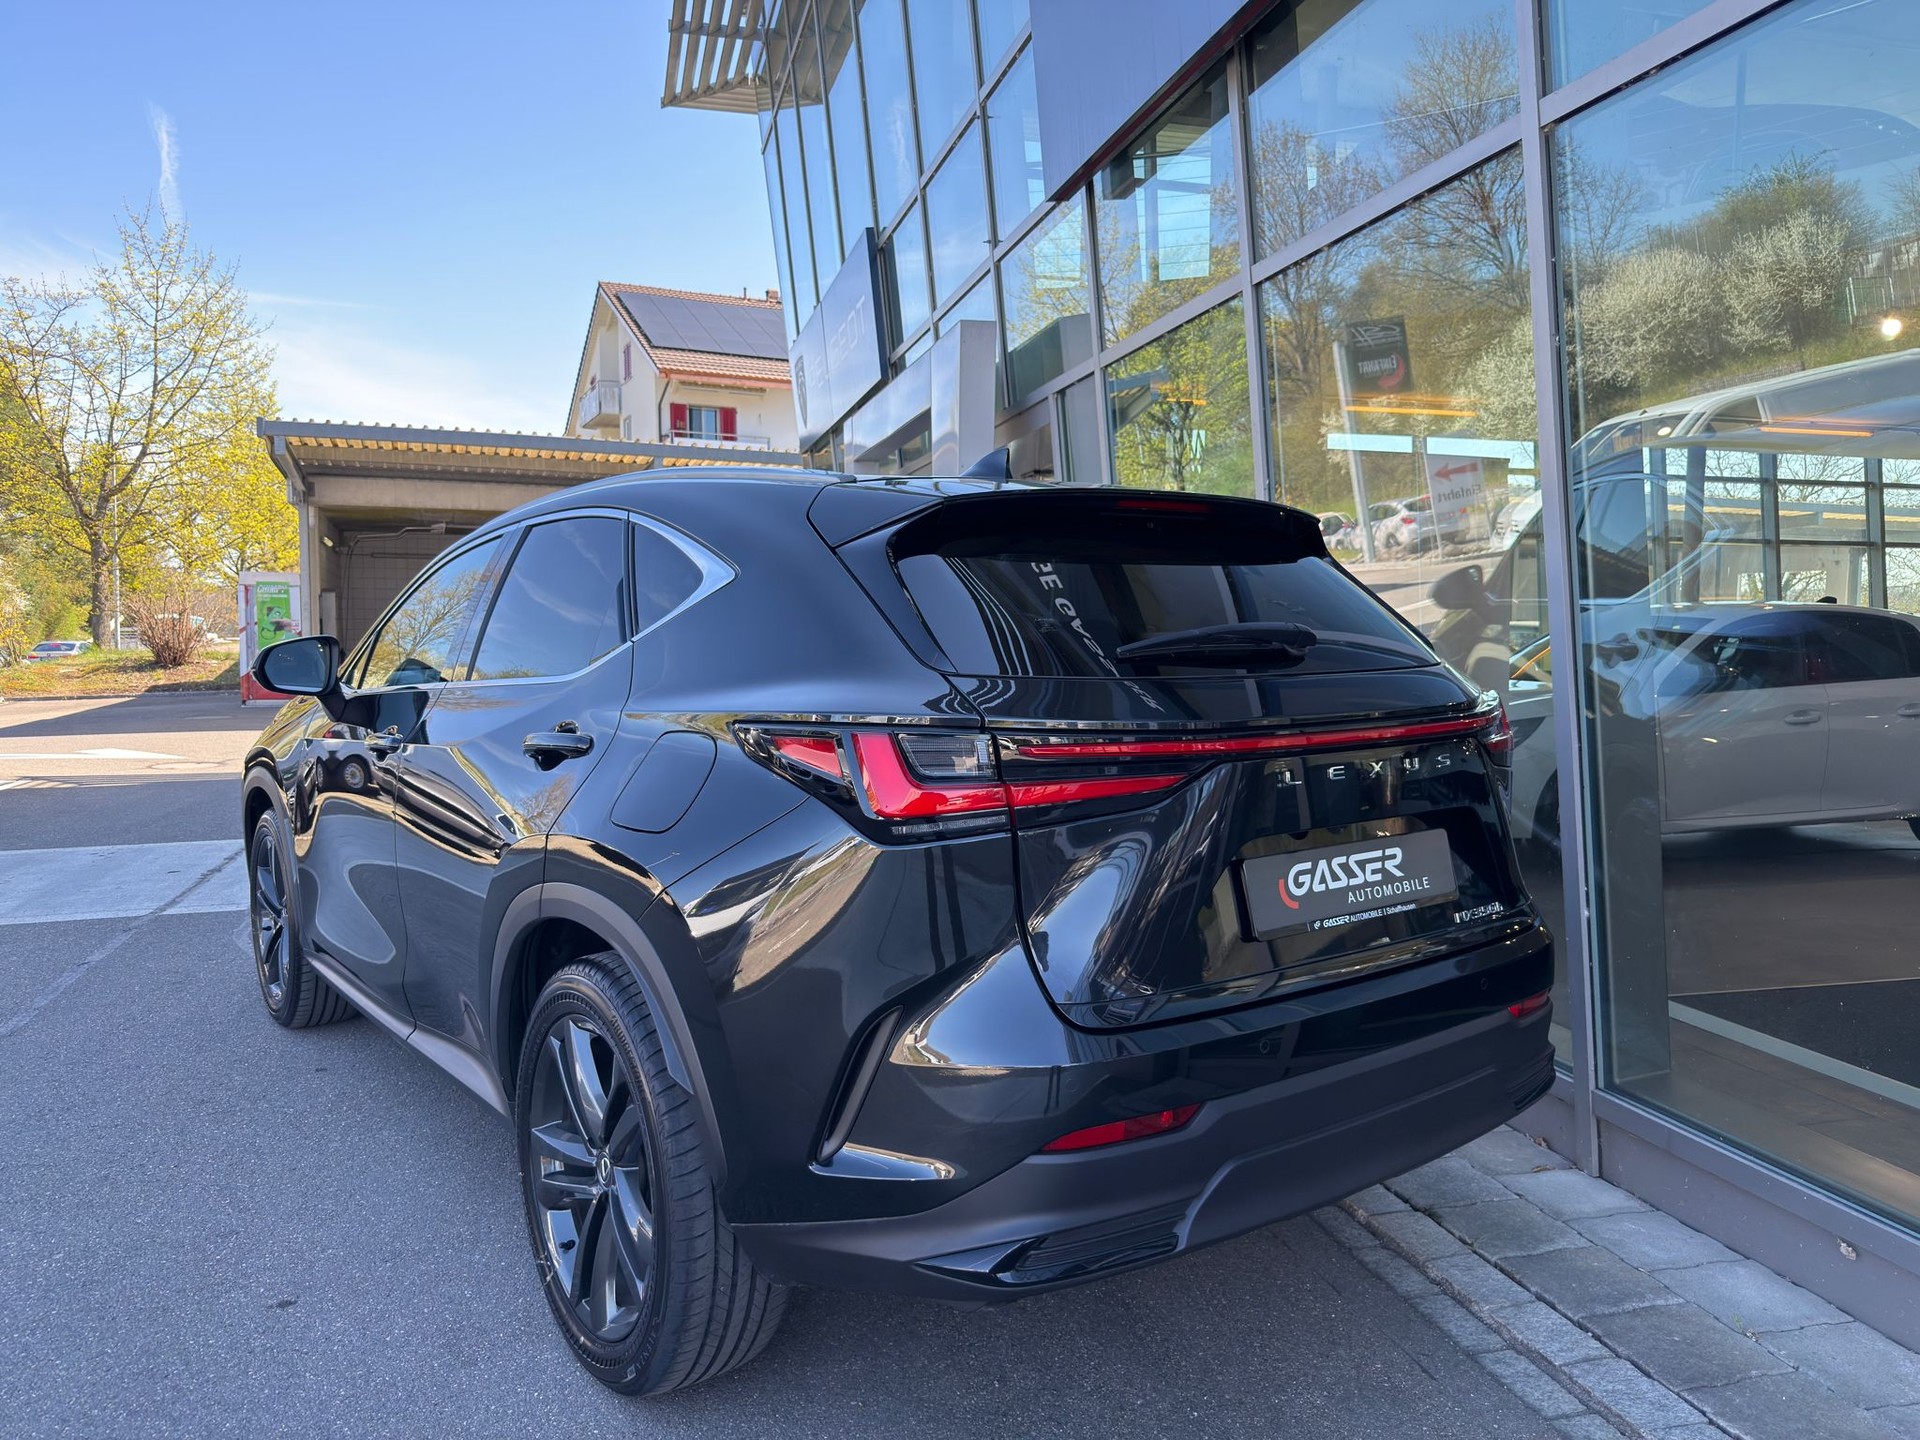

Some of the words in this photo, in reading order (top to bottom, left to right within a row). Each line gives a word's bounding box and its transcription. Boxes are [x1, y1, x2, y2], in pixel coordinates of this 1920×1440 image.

[1283, 754, 1451, 787] LEXUS
[1287, 847, 1405, 896] GASSER
[1347, 876, 1430, 904] AUTOMOBILE
[1323, 915, 1350, 928] GASSER
[1350, 908, 1383, 923] AUTOMOBILE
